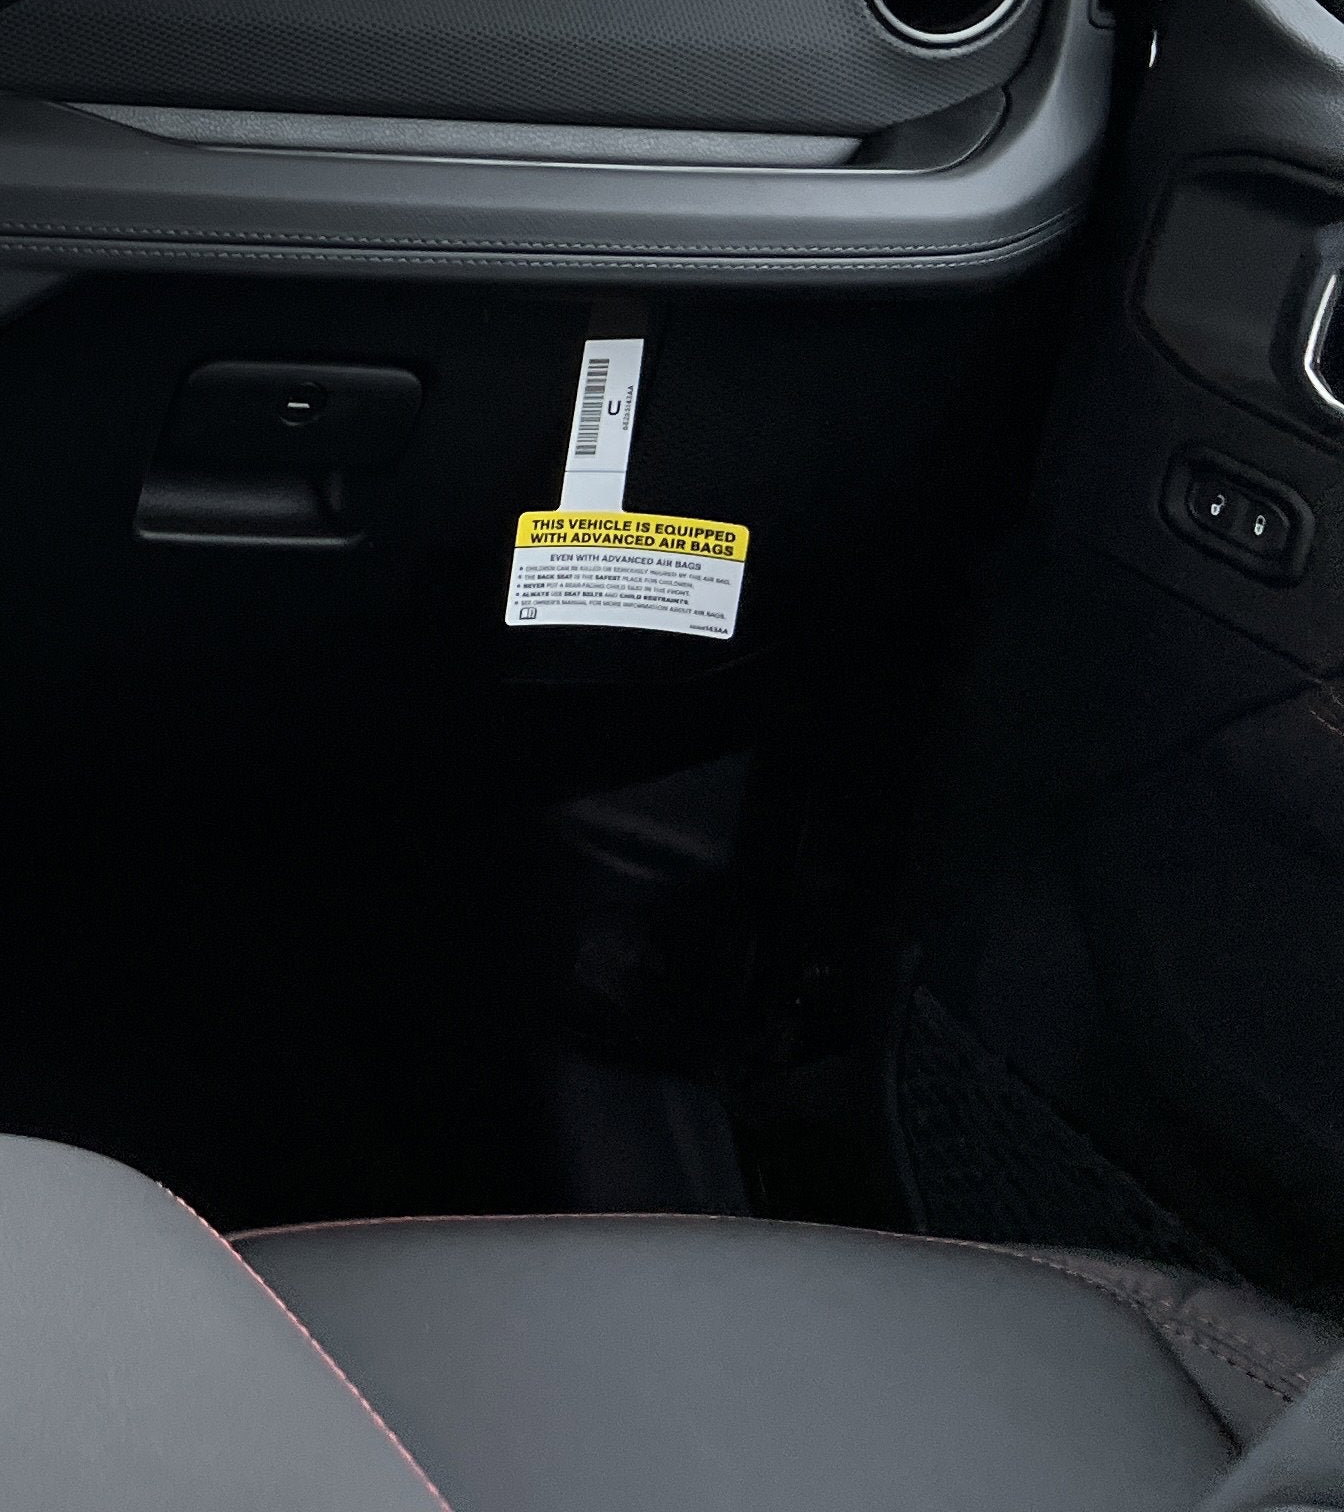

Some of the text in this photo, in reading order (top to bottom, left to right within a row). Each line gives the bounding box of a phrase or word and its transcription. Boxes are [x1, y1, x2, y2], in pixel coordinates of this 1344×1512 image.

[608, 400, 622, 416] U
[532, 518, 737, 544] THIS VEHICLE IS EQUIPPED
[530, 532, 735, 557] WITH ADVANCED AIR BAGS
[549, 553, 702, 571] EVEN WITH ADVANCED AIR BAGS
